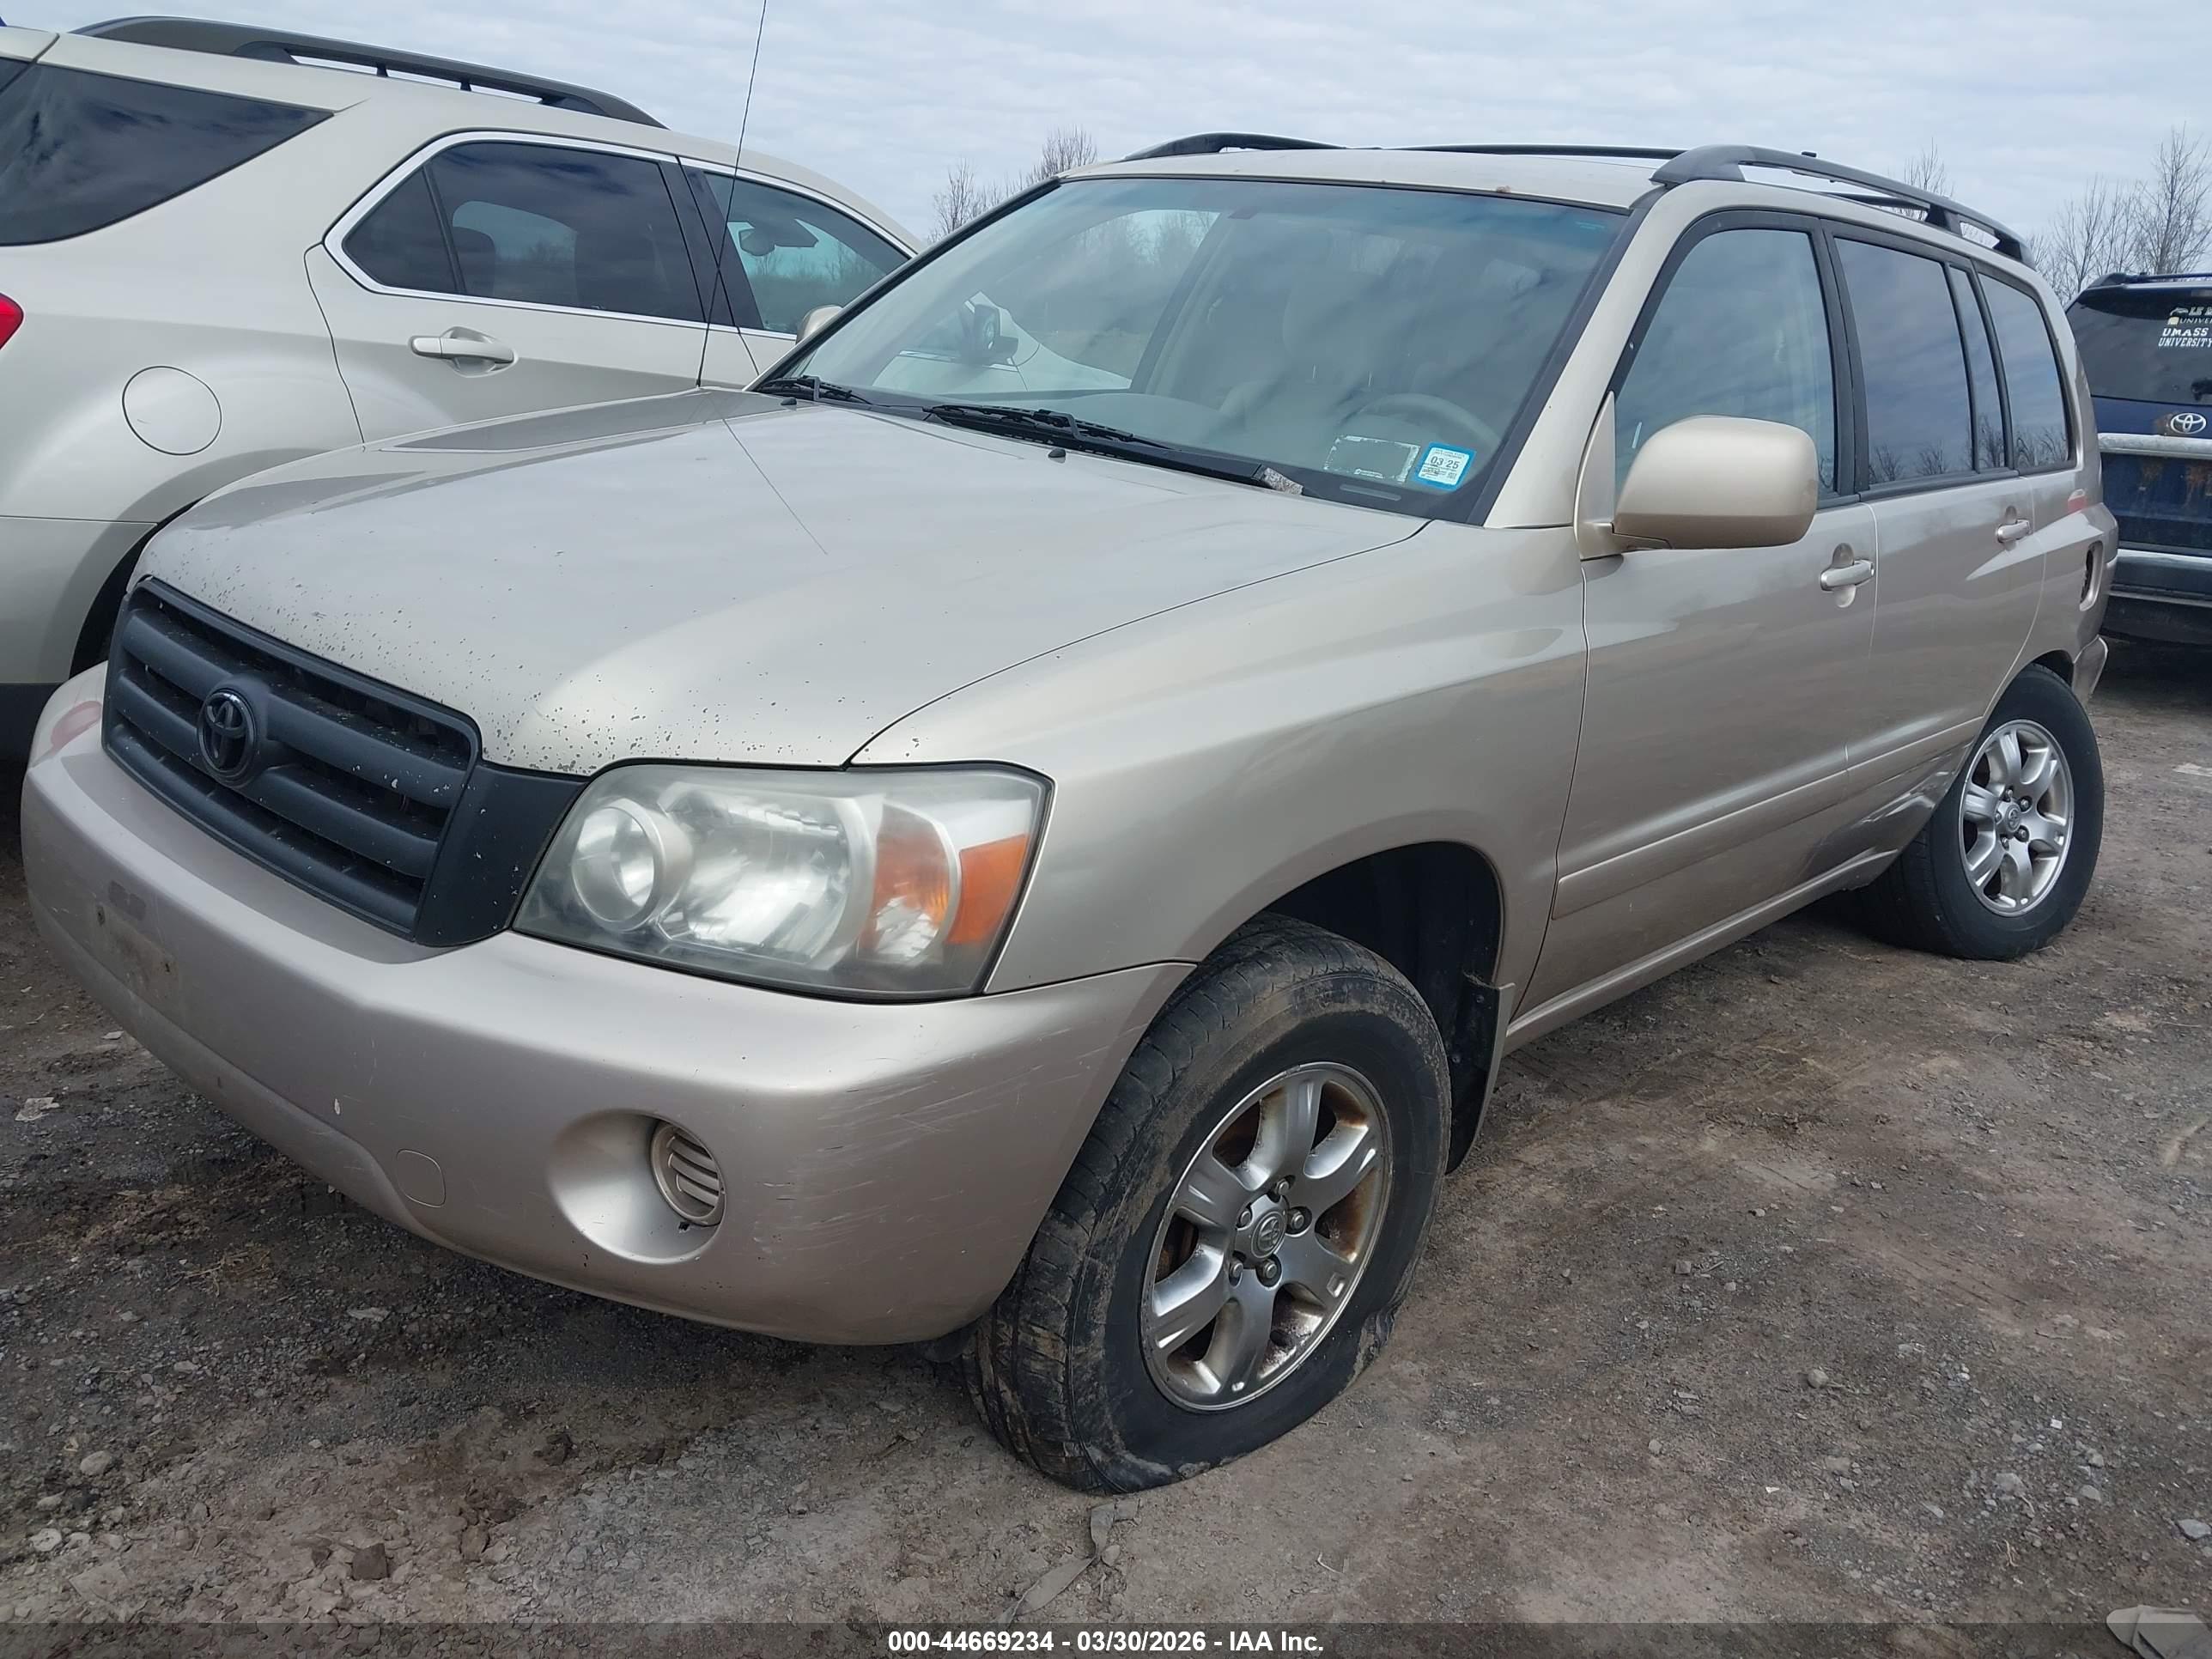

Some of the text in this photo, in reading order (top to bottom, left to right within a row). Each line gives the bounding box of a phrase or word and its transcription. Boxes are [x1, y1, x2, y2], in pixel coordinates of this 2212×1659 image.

[2162, 327, 2209, 337] UMASS
[2158, 337, 2212, 347] UNIVERSITY
[1431, 456, 1460, 470] 03 25
